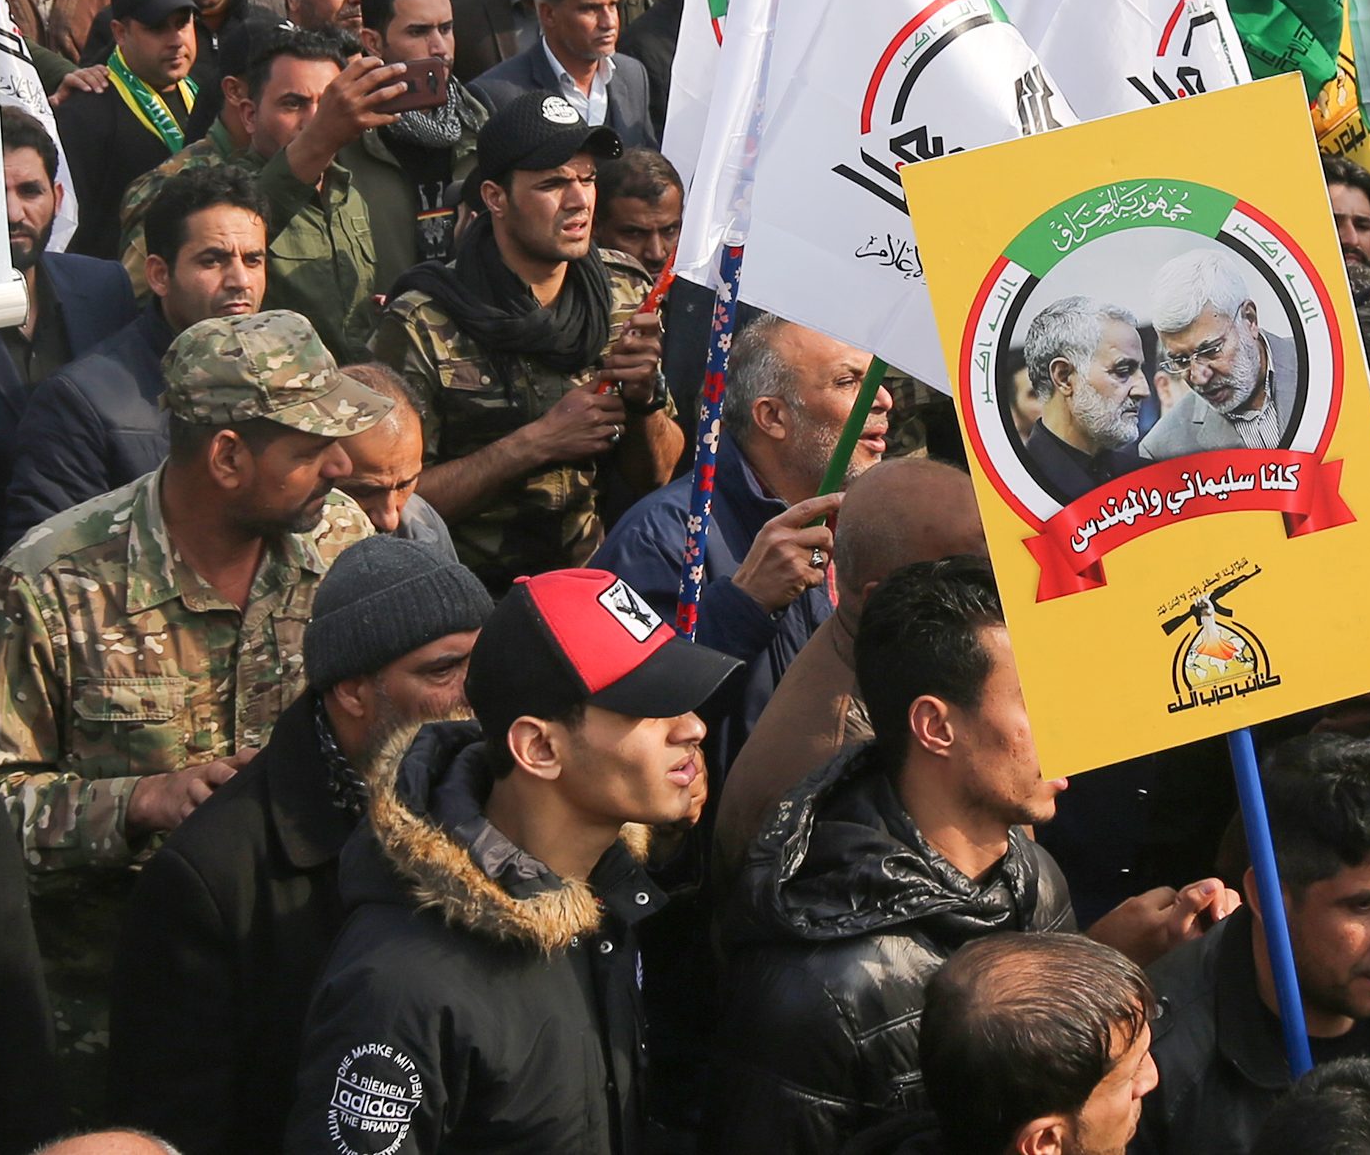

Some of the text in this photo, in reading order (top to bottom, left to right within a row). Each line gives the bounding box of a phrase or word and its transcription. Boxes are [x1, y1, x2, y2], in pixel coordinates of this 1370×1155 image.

[1069, 461, 1301, 553] كلنا سليماني والمهندس
[1167, 673, 1282, 714] كتائب حزب الله
[337, 1043, 424, 1100] DIE MARKE MIT DEN
[351, 1072, 407, 1099] 3 RIEMEN
[338, 1089, 409, 1119] adidas
[328, 1108, 342, 1142] WITH
[339, 1110, 400, 1134] THE BRAND
